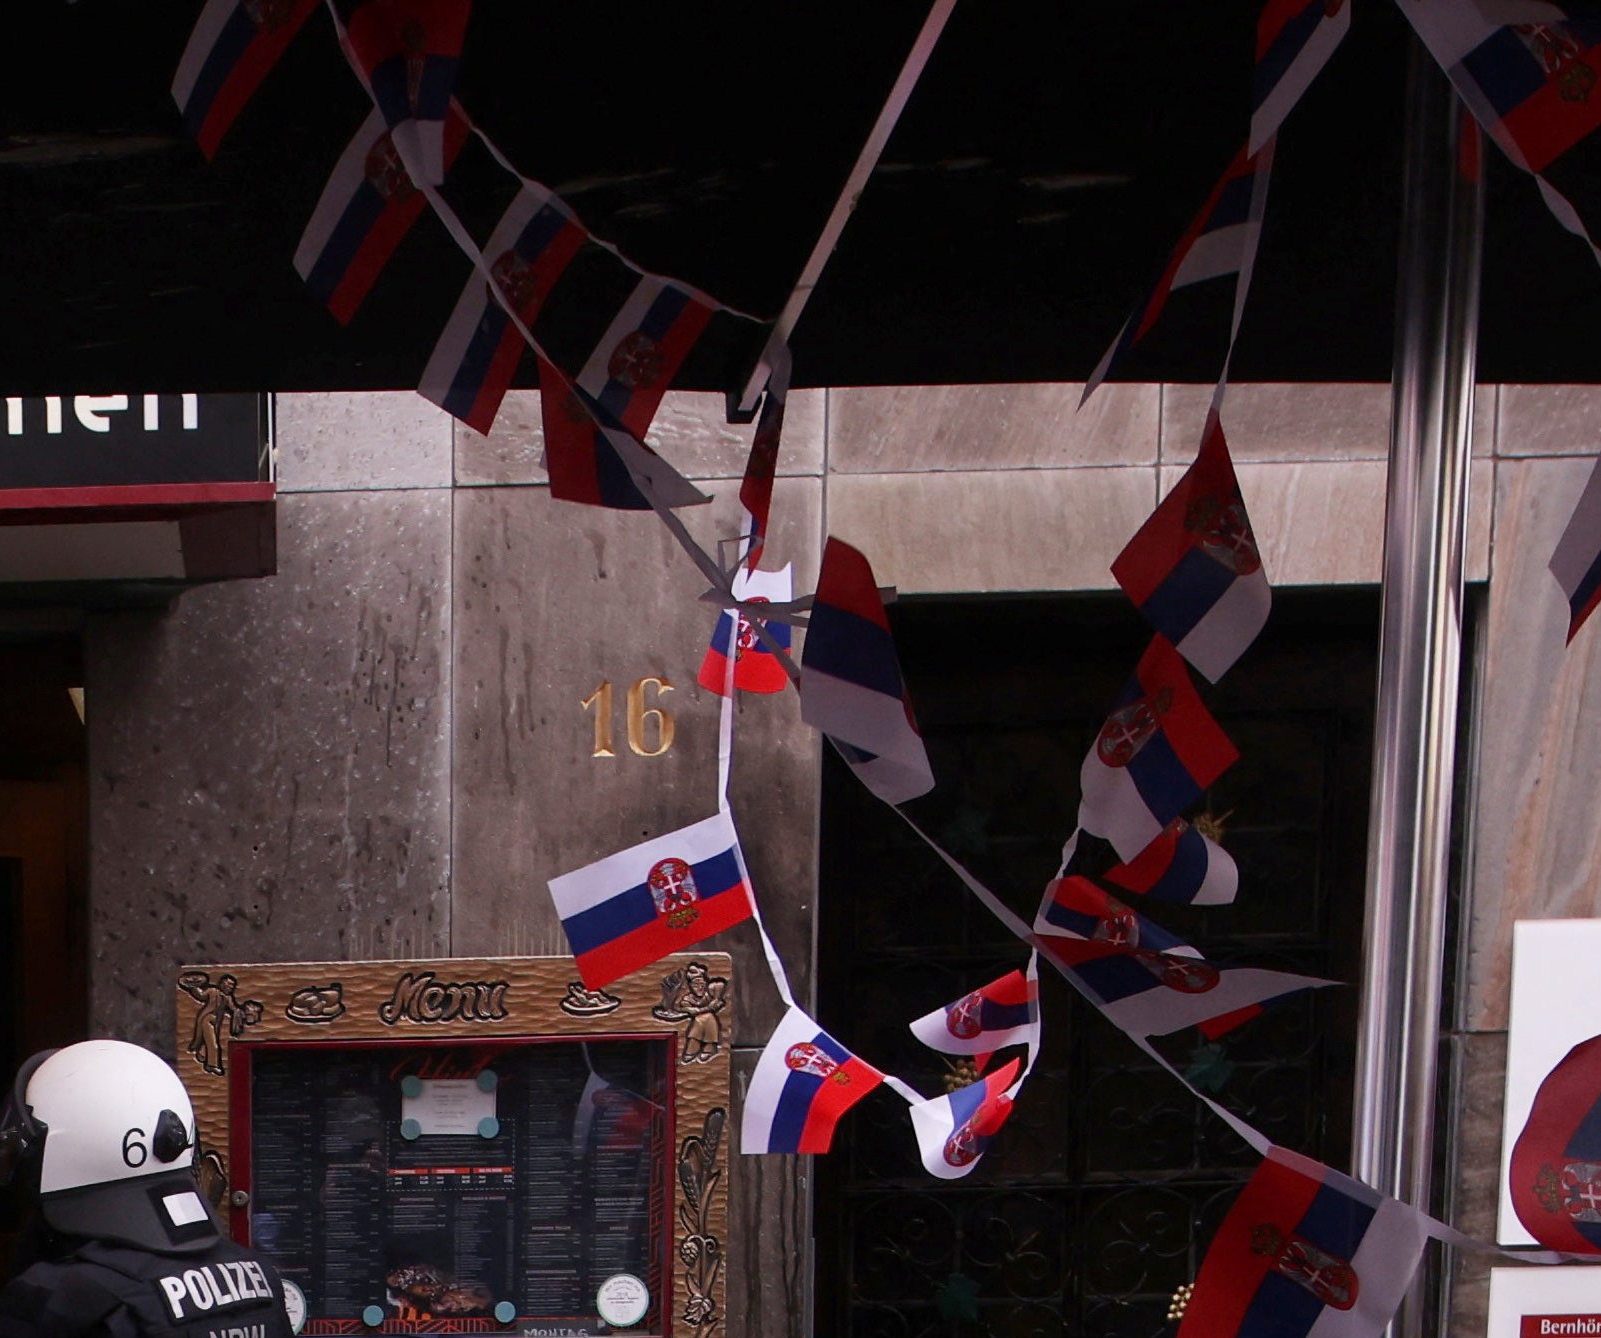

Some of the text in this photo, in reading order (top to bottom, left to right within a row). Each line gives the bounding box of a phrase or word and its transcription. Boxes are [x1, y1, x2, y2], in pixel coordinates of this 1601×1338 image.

[580, 676, 675, 757] 16
[379, 971, 510, 1026] Menu
[123, 1128, 147, 1168] 6
[160, 1260, 274, 1320] POLIZEI
